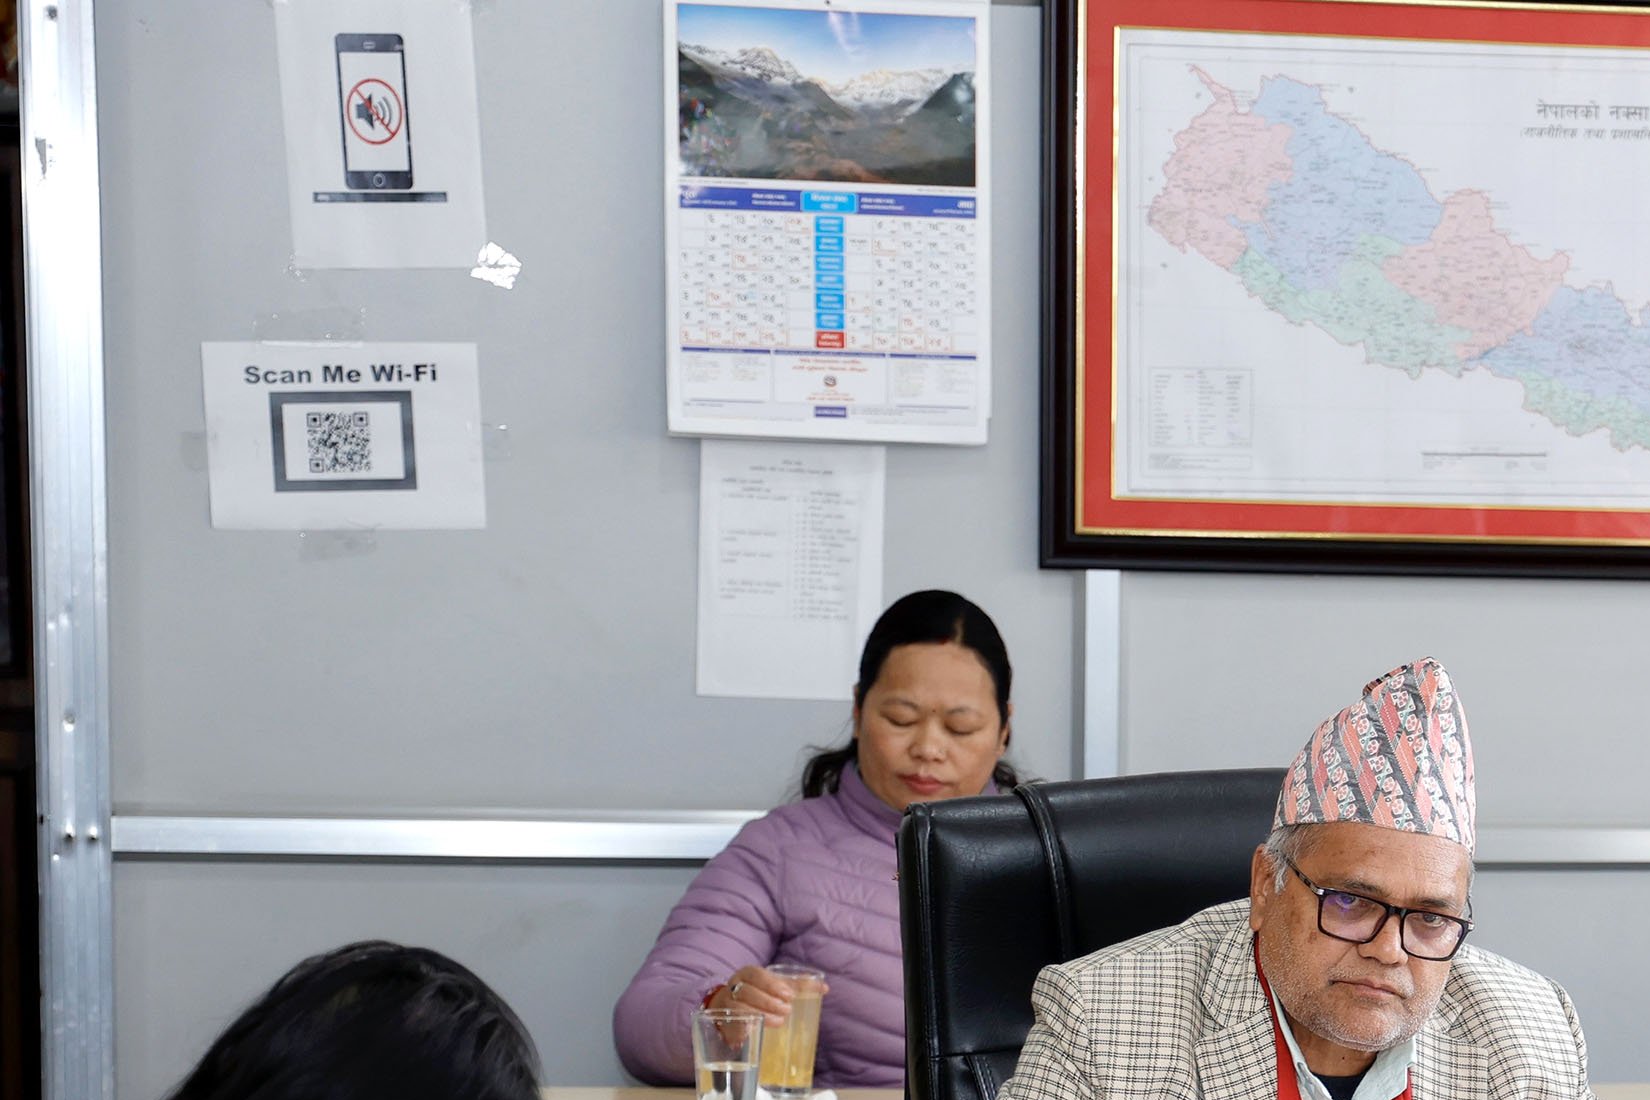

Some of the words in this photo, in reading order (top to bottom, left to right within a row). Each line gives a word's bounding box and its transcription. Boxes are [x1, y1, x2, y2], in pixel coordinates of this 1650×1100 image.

[1536, 99, 1600, 120] नेपालको
[1609, 105, 1650, 121] नक्सा
[244, 365, 312, 384] Scan
[322, 365, 361, 383] Me
[370, 363, 438, 382] Wi-Fi
